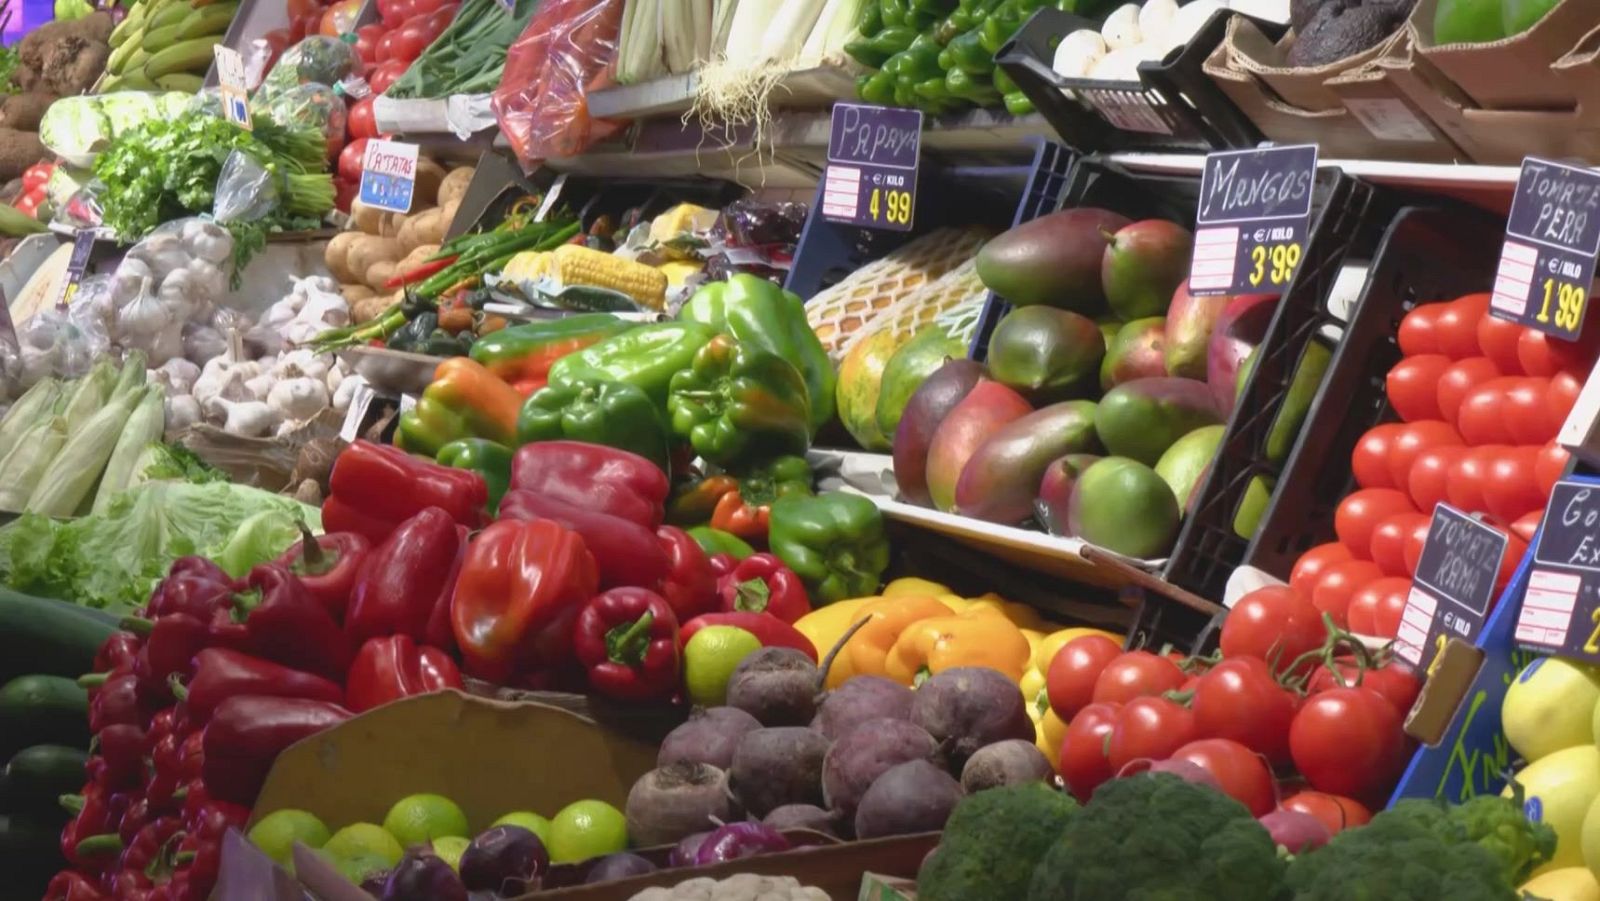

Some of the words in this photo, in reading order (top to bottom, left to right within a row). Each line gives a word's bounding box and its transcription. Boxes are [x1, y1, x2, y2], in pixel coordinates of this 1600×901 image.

[836, 107, 918, 160] PAPAYA
[367, 142, 413, 174] PATATAS
[1202, 158, 1310, 216] MANGOS
[1523, 165, 1600, 208] TOMATE
[1530, 202, 1588, 244] PERA
[1433, 550, 1480, 599] RAMA
